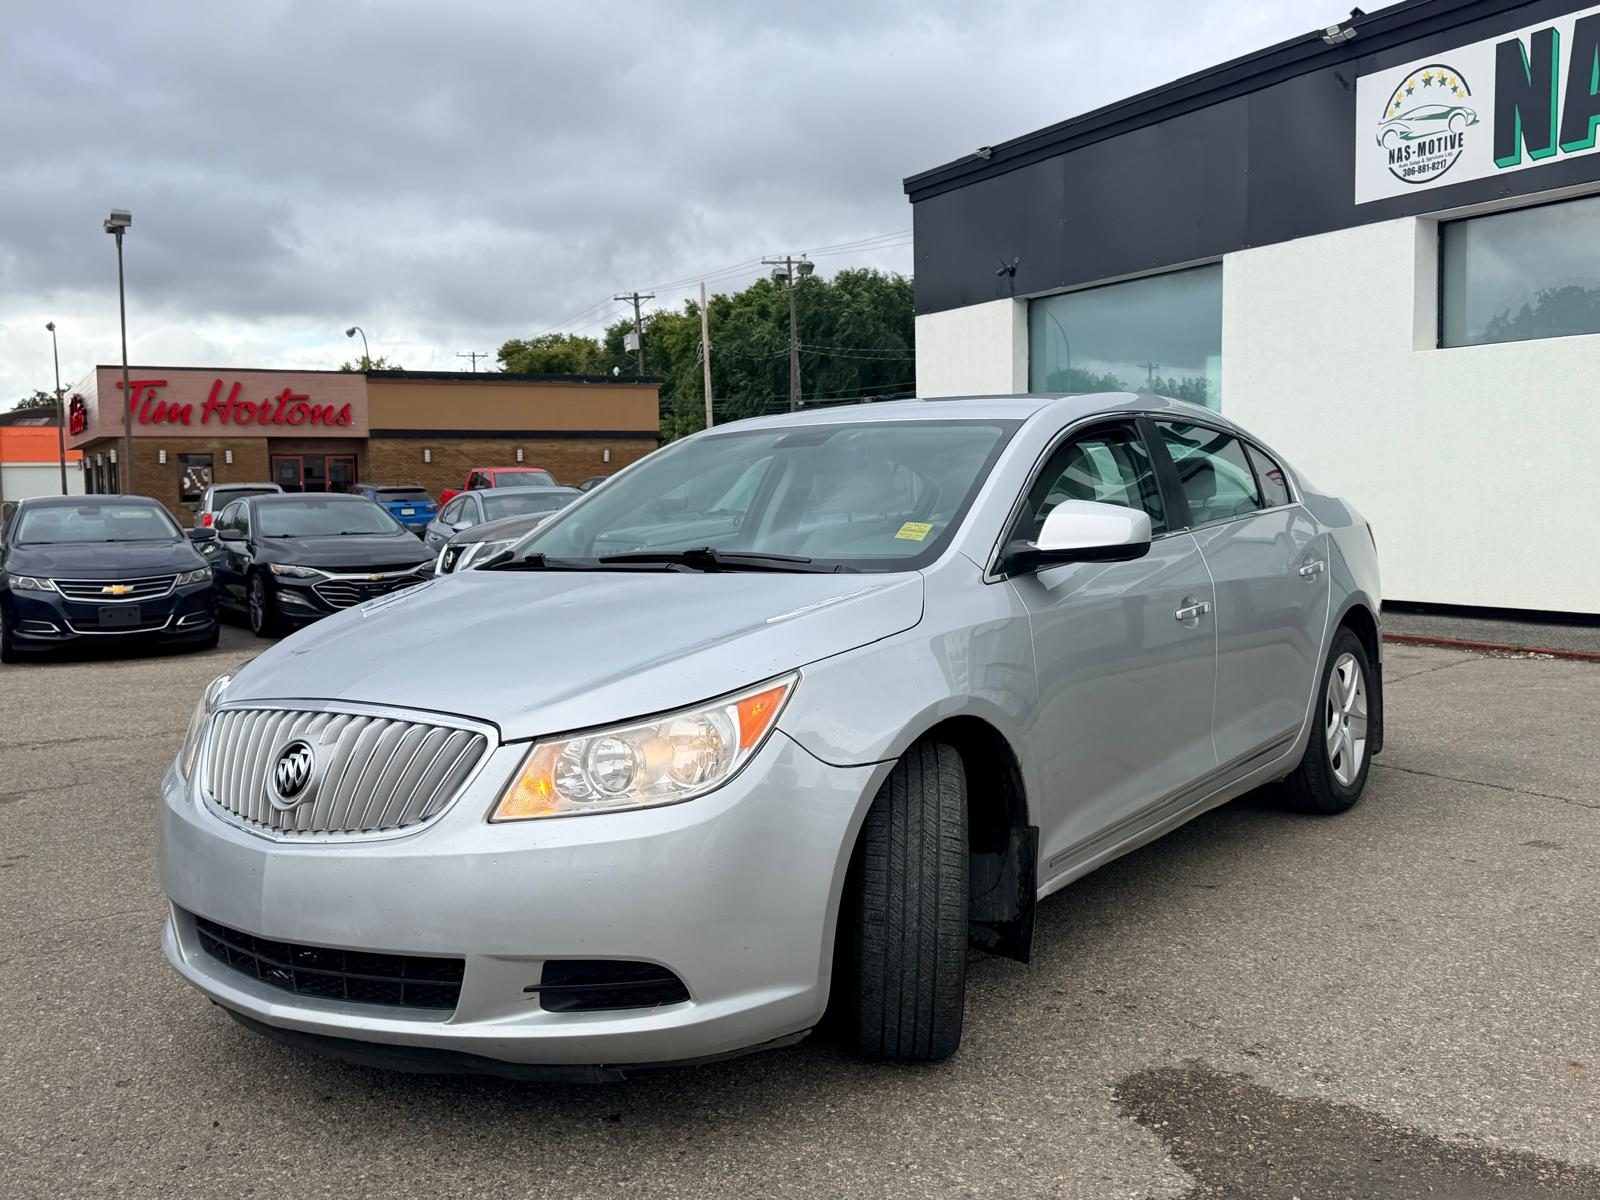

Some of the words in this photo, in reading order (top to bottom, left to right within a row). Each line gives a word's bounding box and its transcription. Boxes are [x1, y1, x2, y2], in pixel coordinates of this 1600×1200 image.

[1389, 132, 1463, 165] NAS-MOTIVE
[115, 379, 193, 425] Tim
[200, 378, 353, 426] Hortons
